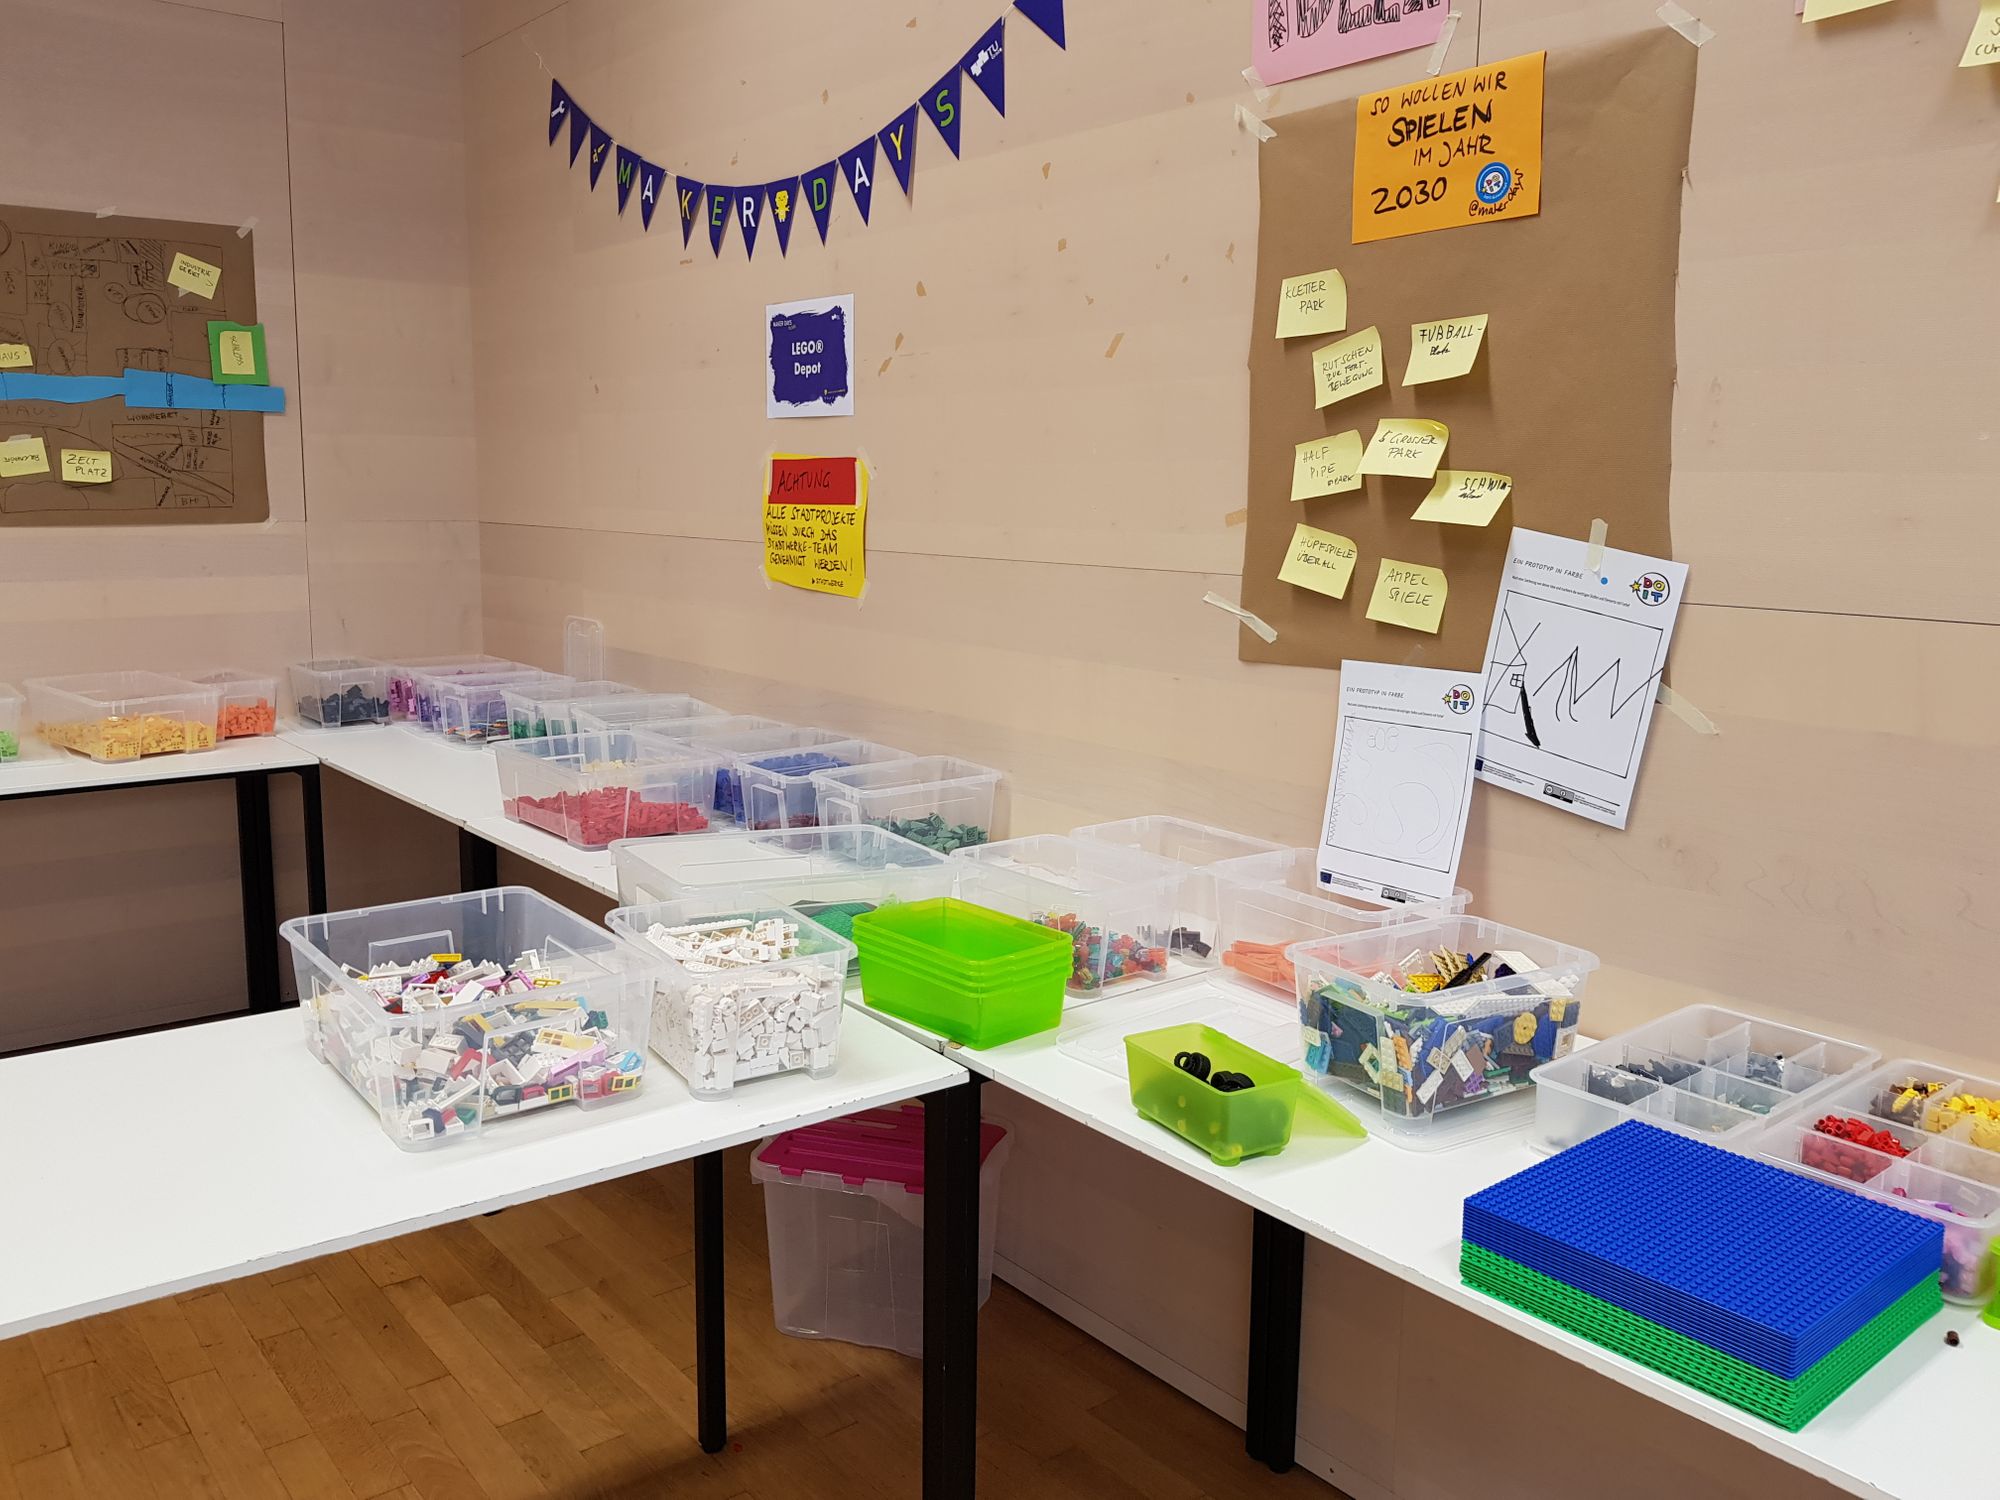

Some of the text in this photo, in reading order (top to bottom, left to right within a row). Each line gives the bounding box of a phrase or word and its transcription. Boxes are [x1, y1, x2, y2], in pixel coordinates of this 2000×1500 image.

[1370, 71, 1508, 116] SO WOLLEN WIR
[1387, 99, 1493, 147] SPIELEN
[618, 89, 955, 228] MAKER DAYS
[1413, 133, 1496, 167] IM JAHR
[1371, 176, 1447, 214] 2030
[1285, 280, 1327, 299] KLETTER
[1299, 298, 1327, 315] PARK
[1322, 344, 1374, 375] RUTSCHEN
[794, 362, 822, 378] Depot
[66, 453, 99, 465] ZELT
[1302, 446, 1331, 464] HALF
[1387, 447, 1423, 459] PARK
[75, 465, 108, 478] PLATZ
[1310, 462, 1337, 479] PIPE
[777, 468, 832, 495] ACHTUNG
[766, 505, 856, 526] ALLE STADTPROJEKTE
[820, 528, 838, 542] DAS
[1384, 567, 1429, 586] AMPEL
[1512, 557, 1584, 580] EIN PROTOTYP IN FARBE
[1643, 576, 1666, 592] DO
[1388, 587, 1433, 607] SPIELE
[1642, 589, 1664, 603] IT
[1452, 689, 1471, 701] DO
[1452, 700, 1470, 711] IT
